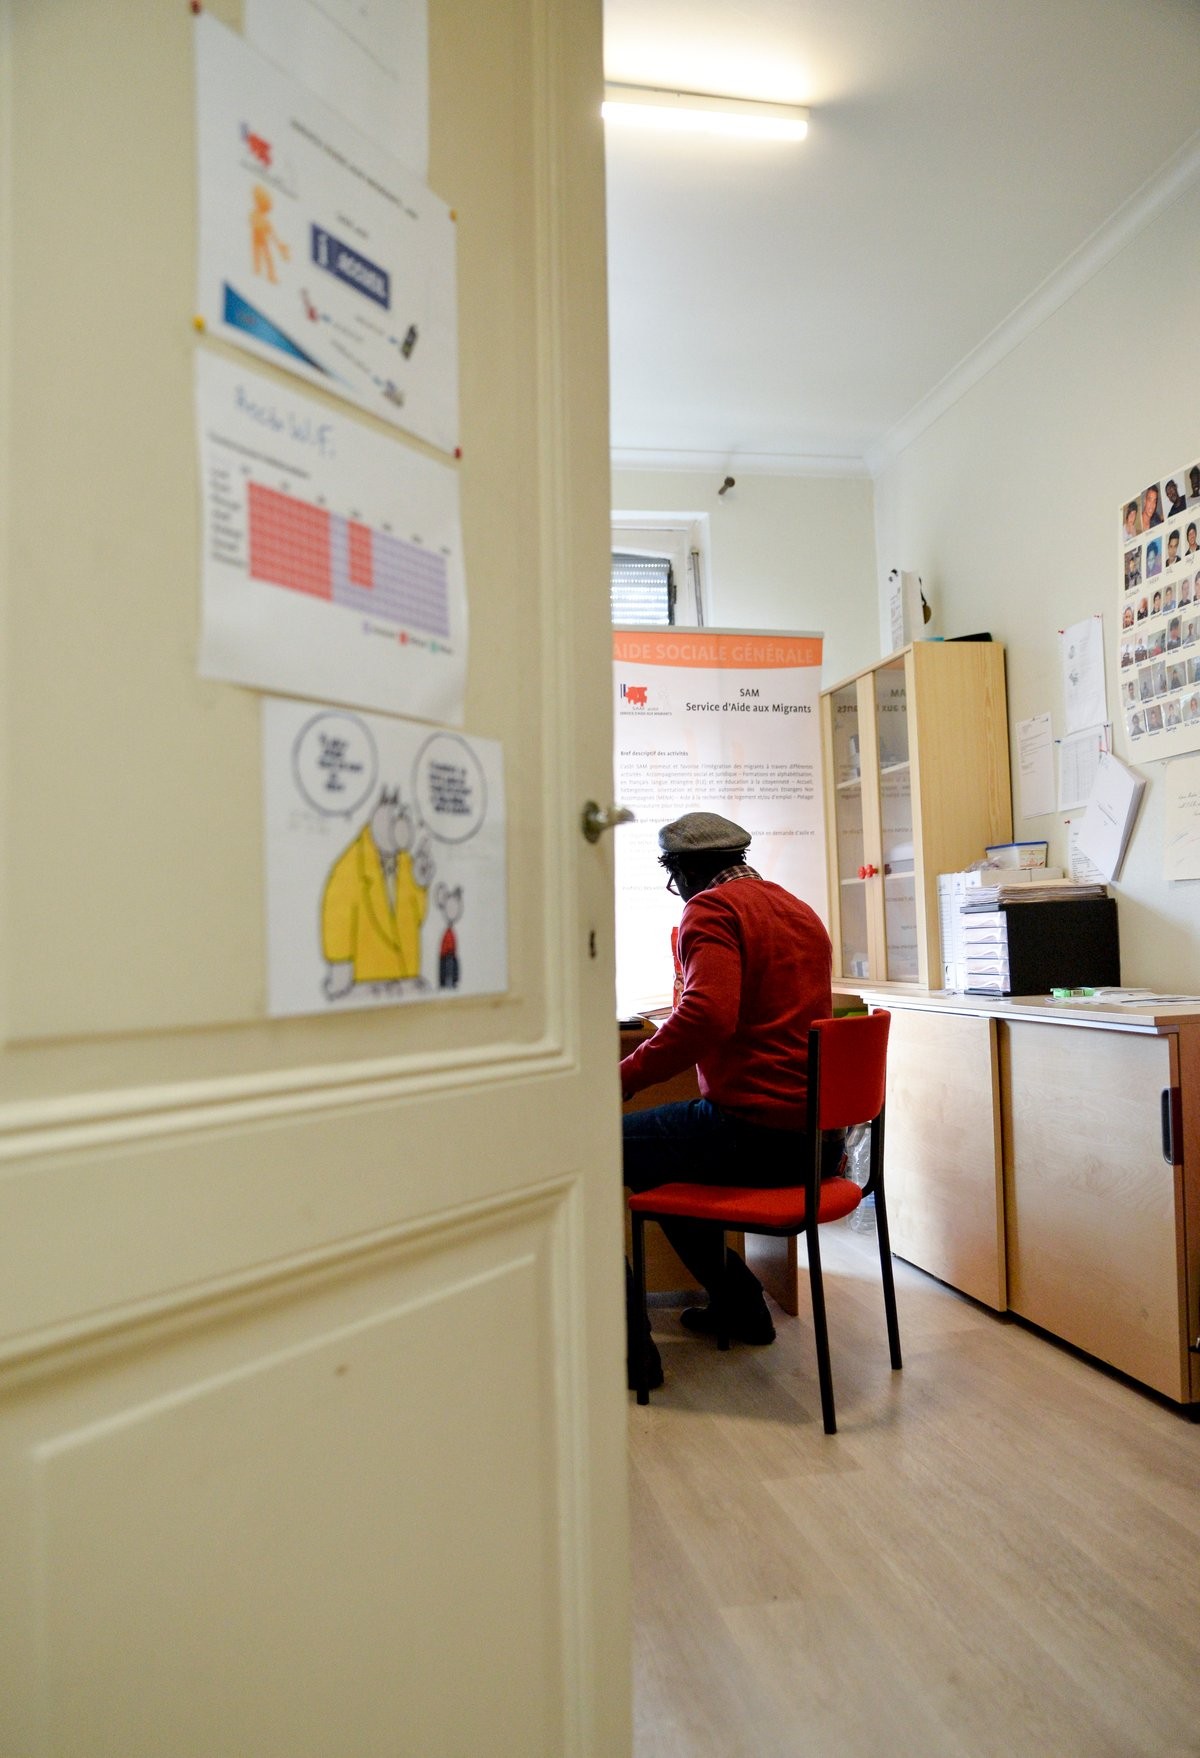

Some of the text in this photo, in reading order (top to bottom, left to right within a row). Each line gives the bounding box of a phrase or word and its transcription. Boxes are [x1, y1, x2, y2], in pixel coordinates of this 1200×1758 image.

[613, 642, 815, 664] AIDE SOCIALE GÉNÉRALE
[740, 688, 760, 697] SAM
[686, 702, 812, 715] Service d'Aide aux Migrants
